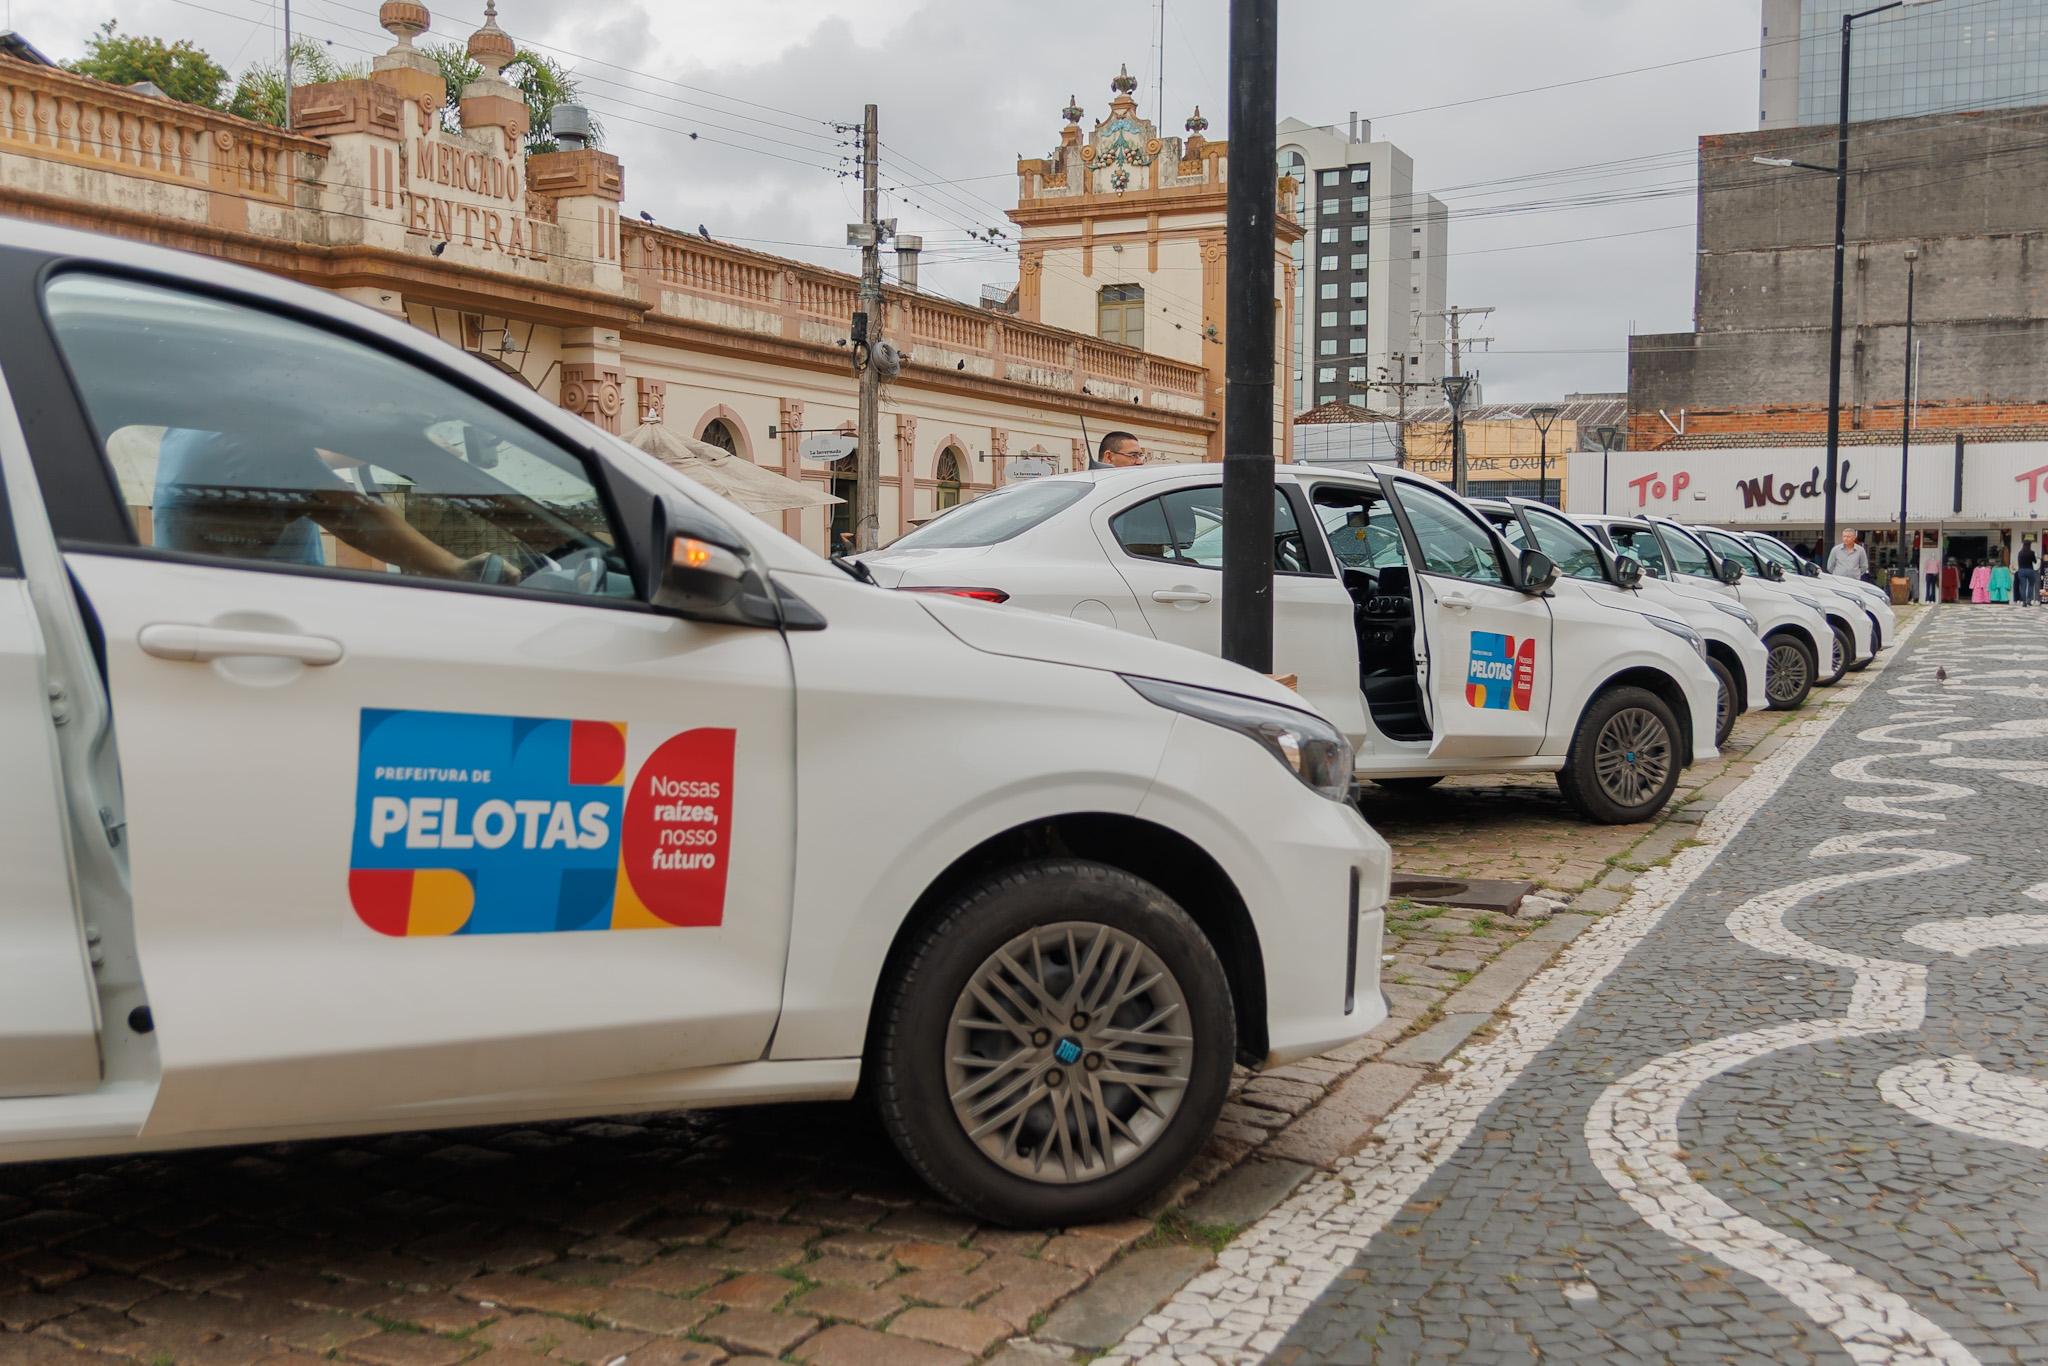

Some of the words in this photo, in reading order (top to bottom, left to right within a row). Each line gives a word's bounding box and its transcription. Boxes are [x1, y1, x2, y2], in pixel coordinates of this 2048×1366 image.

[416, 137, 519, 201] MERCADO
[2015, 464, 2048, 503] T
[1470, 660, 1513, 681] PELOTAS
[374, 766, 469, 783] PREFEITURA
[472, 769, 491, 783] DE
[651, 775, 720, 798] Nossas
[369, 796, 610, 849] PELOTAS
[654, 800, 719, 825] raízes,
[660, 828, 717, 846] nosso
[652, 848, 715, 870] futuro
